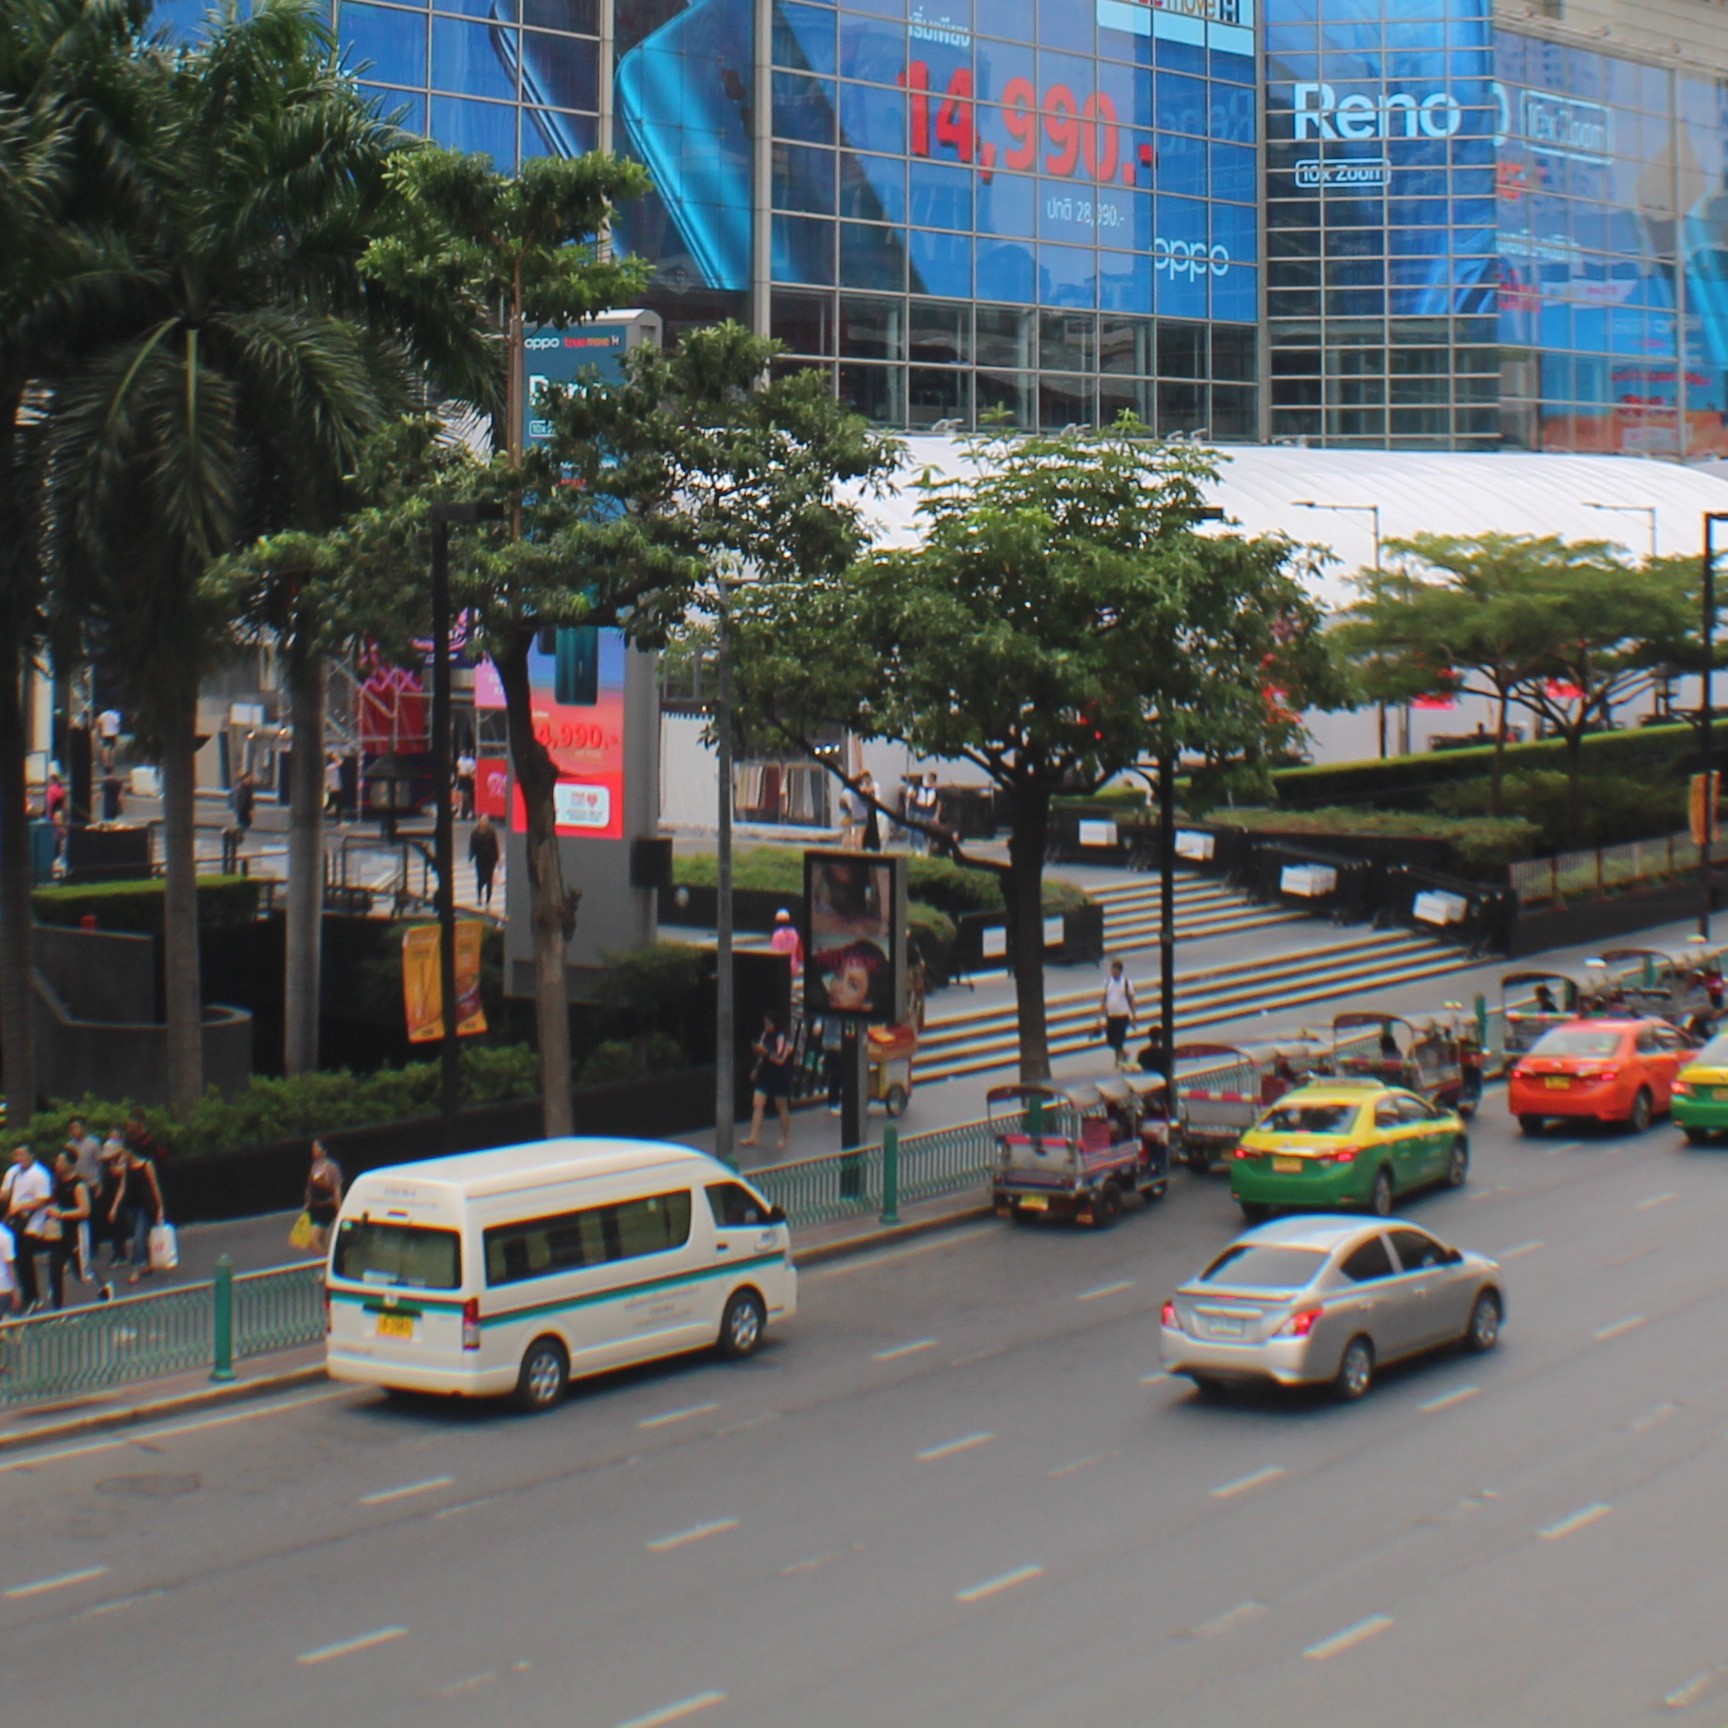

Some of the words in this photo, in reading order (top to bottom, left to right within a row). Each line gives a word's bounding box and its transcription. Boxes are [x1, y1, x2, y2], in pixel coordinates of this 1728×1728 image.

[897, 60, 1158, 186] 14,990.-
[1294, 83, 1461, 141] Reno
[1302, 164, 1332, 183] 10x
[1335, 163, 1382, 183] Zoom
[1154, 237, 1229, 282] oppo
[524, 338, 560, 350] oppo
[534, 722, 619, 750] 4,990.-
